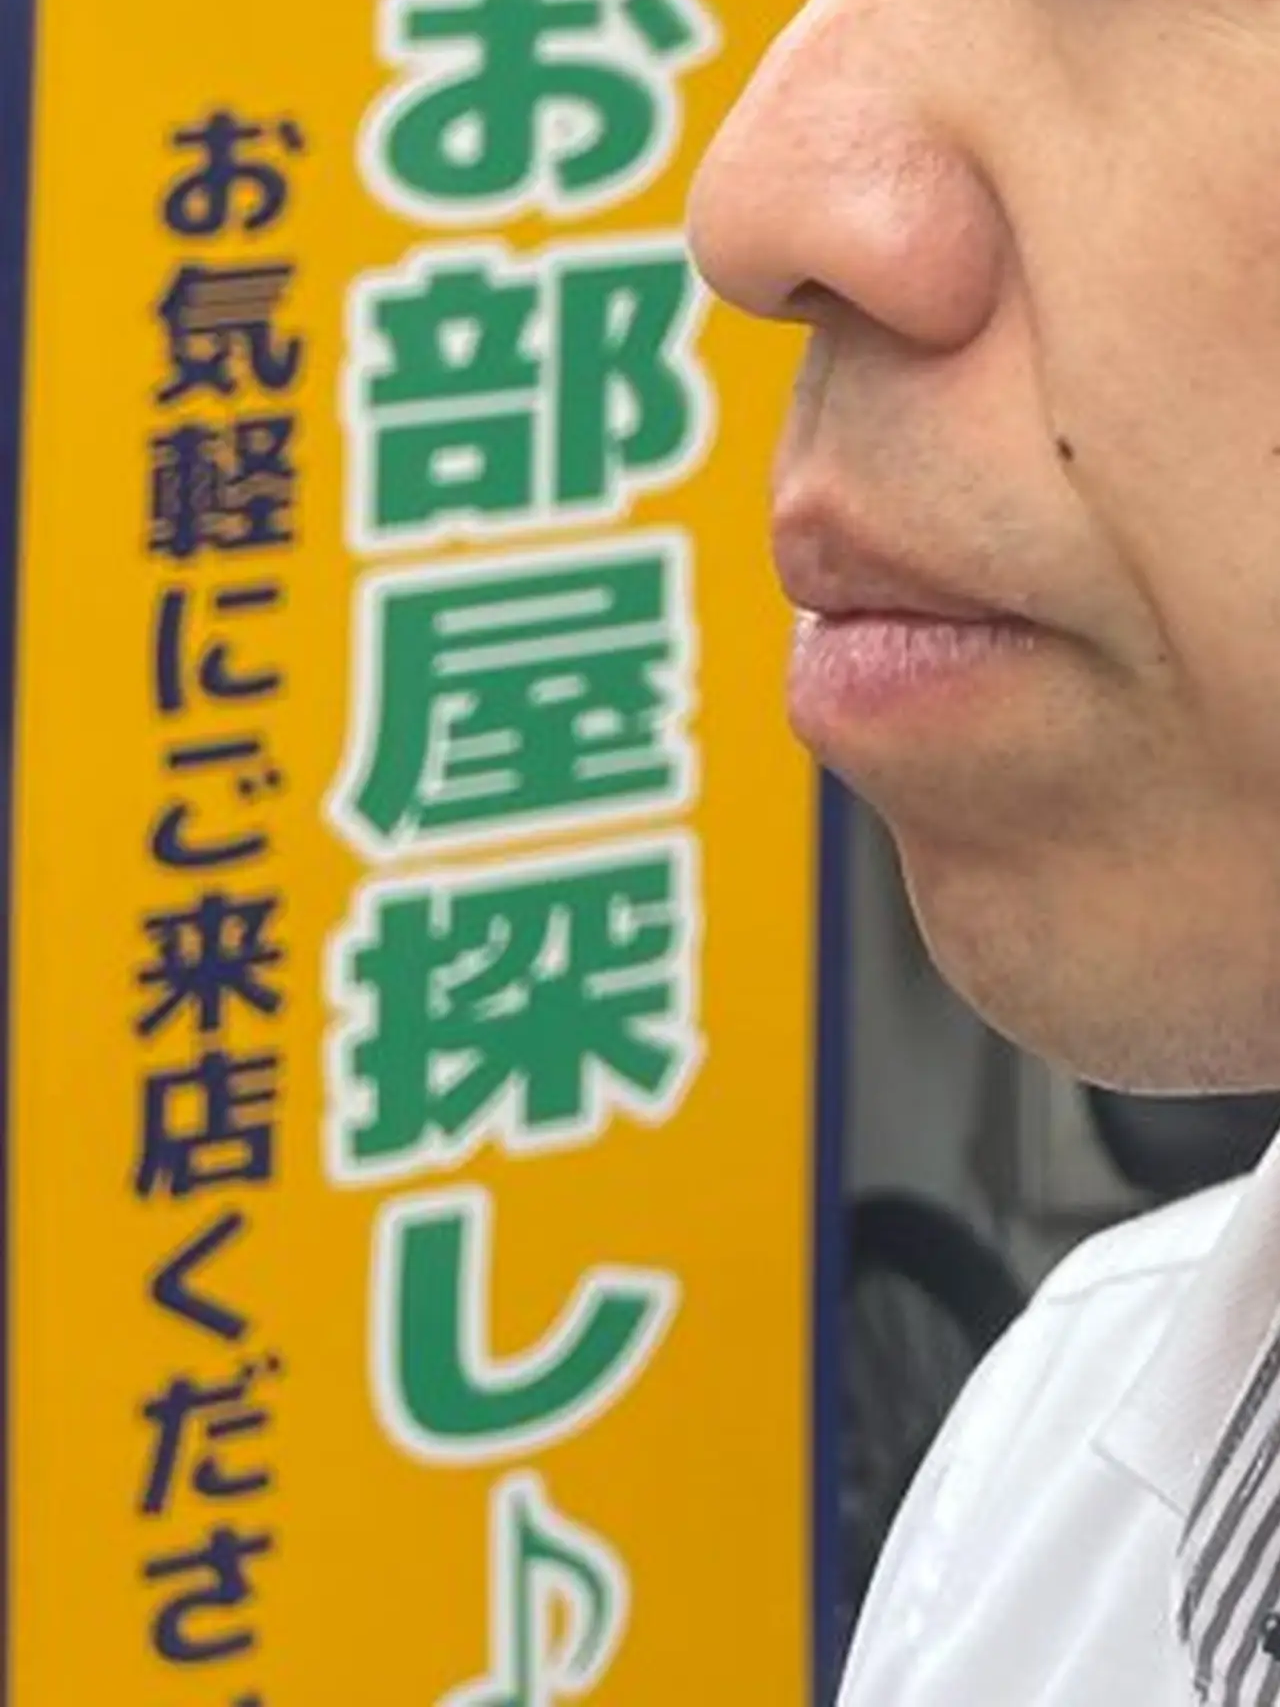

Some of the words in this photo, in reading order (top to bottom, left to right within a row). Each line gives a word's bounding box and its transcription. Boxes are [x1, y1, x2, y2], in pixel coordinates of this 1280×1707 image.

[134, 107, 306, 1707] お気軽にご来店くださ
